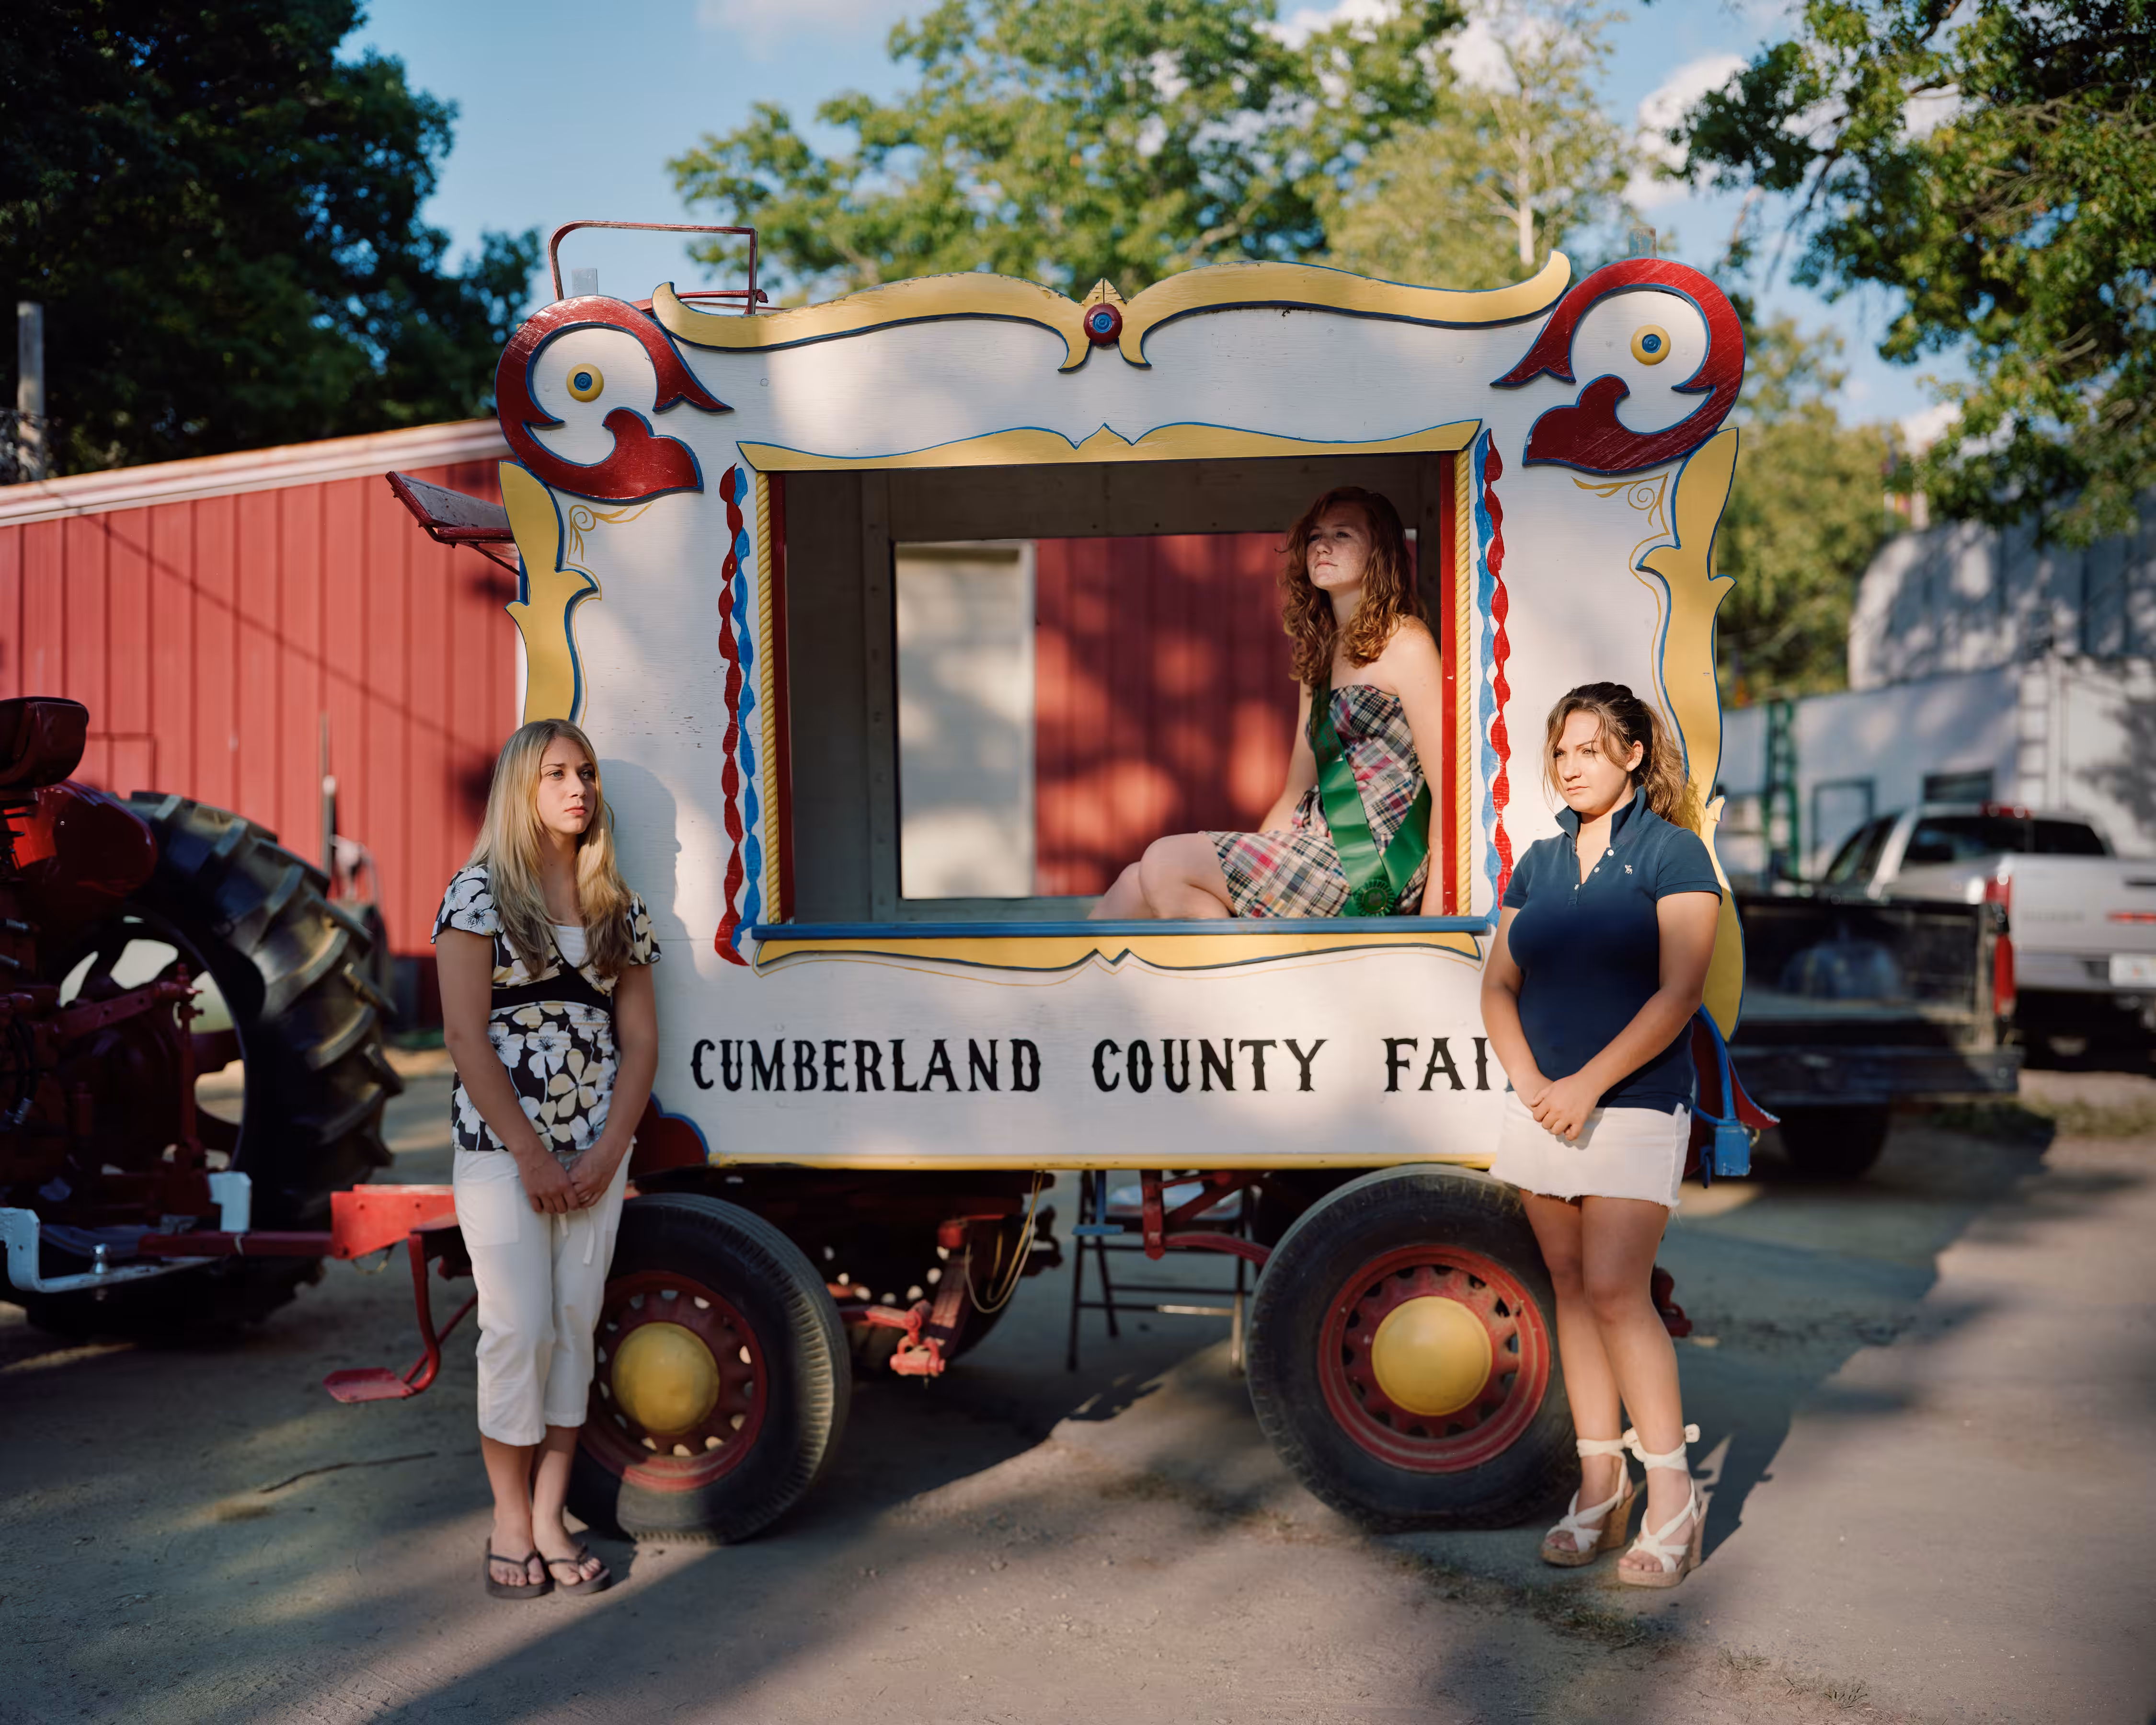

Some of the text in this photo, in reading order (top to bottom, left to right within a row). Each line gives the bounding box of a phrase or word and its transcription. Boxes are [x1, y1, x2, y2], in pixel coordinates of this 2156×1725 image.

[690, 1036, 1515, 1093] CUMBERLAND COUNTY FAI
